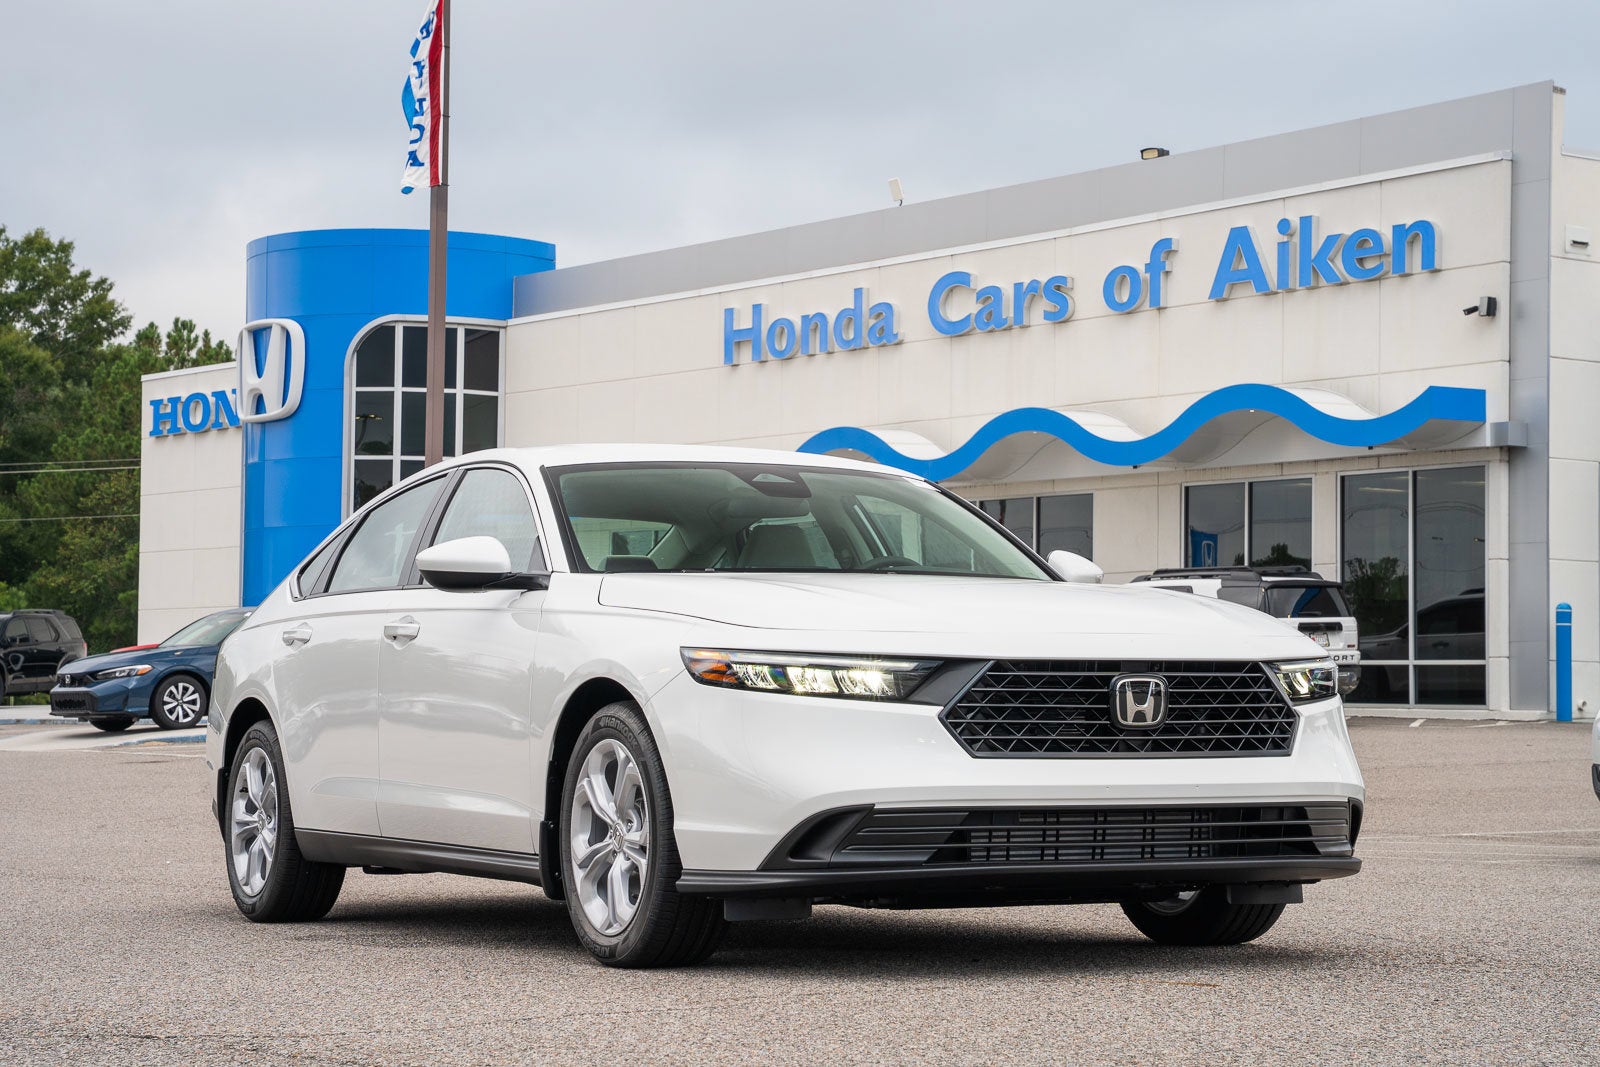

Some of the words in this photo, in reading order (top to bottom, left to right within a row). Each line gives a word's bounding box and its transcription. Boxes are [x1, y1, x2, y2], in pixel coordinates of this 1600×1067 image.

[723, 287, 901, 366] Honda
[927, 270, 1073, 337] Cars
[1102, 236, 1177, 313] of
[1207, 214, 1437, 301] Aiken
[149, 388, 241, 437] HON
